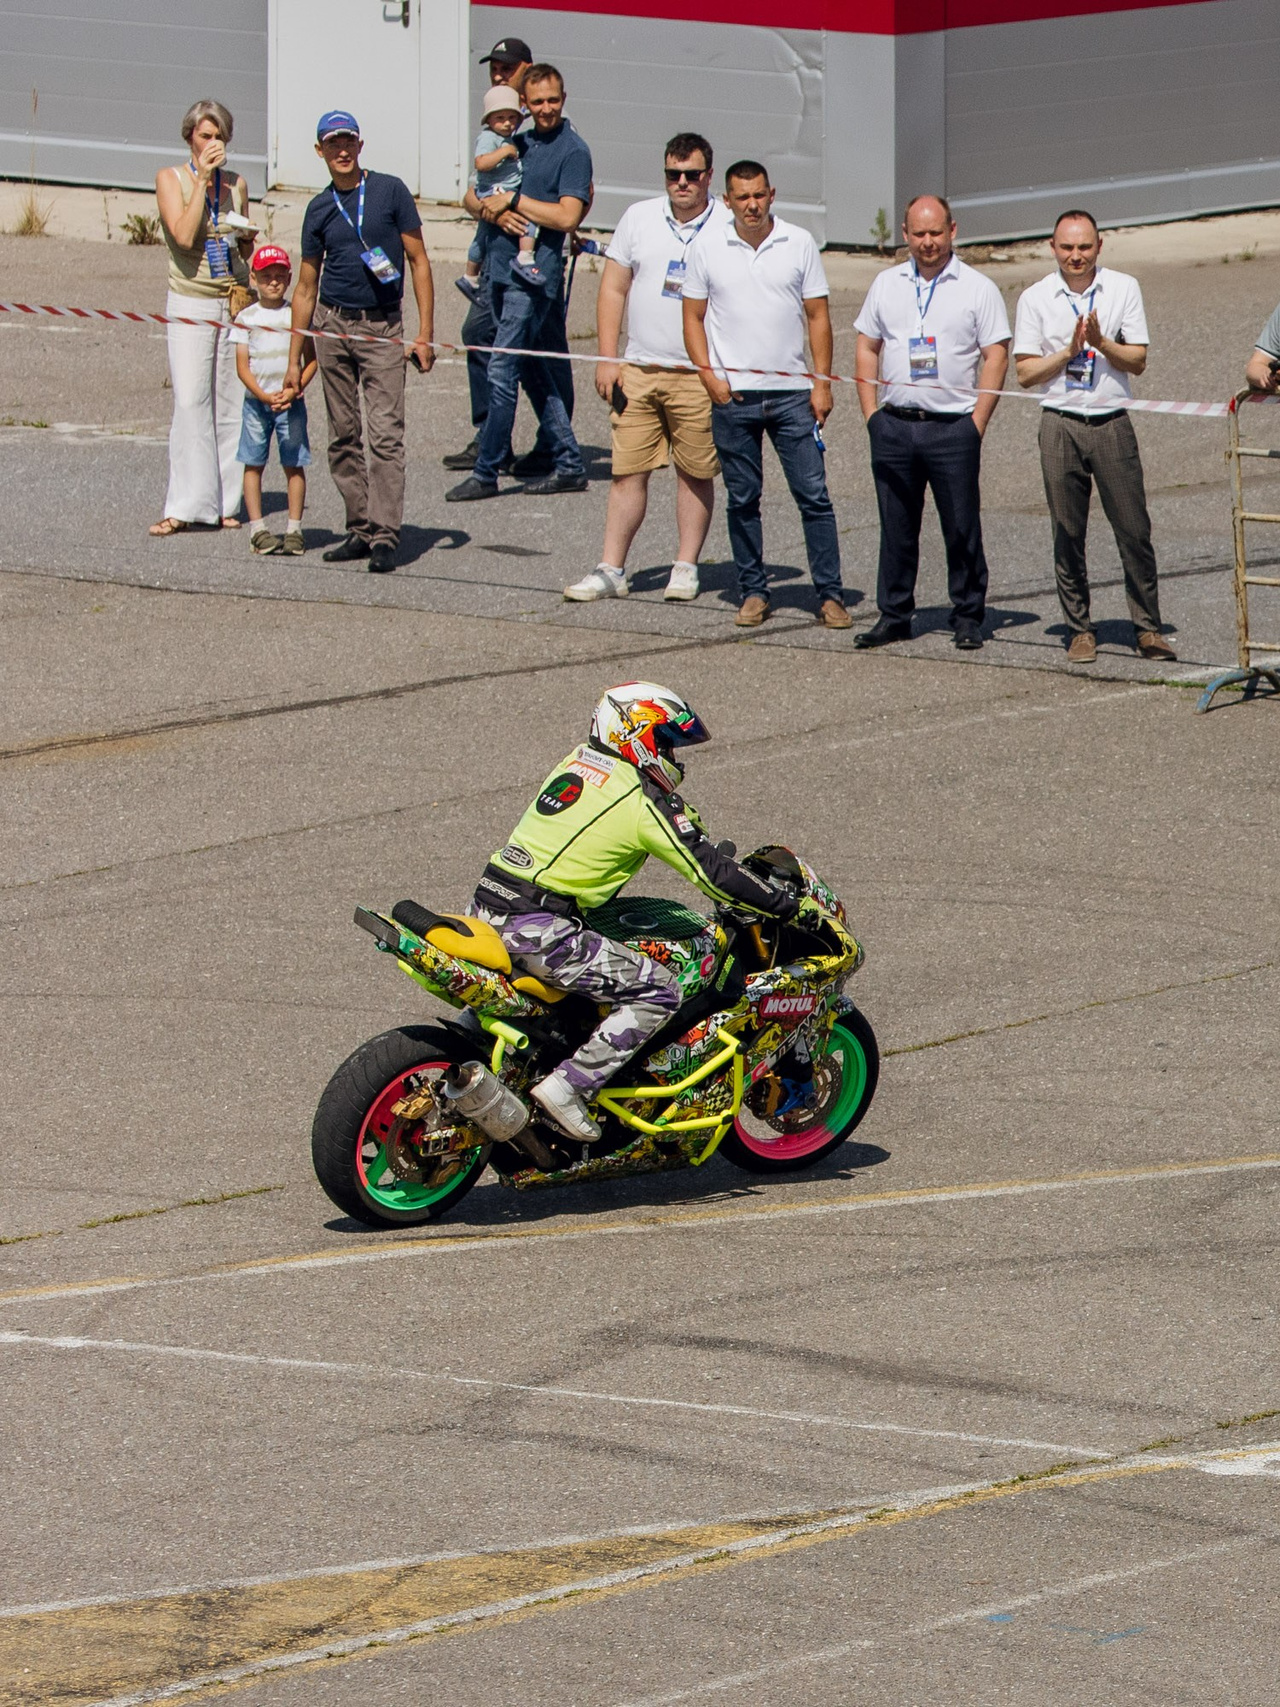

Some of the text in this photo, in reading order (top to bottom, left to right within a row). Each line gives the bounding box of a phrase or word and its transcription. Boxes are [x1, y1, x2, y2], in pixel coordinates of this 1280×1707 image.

[566, 763, 606, 786] MOTUL
[540, 794, 563, 809] TEAM
[763, 997, 814, 1014] MOTUL
